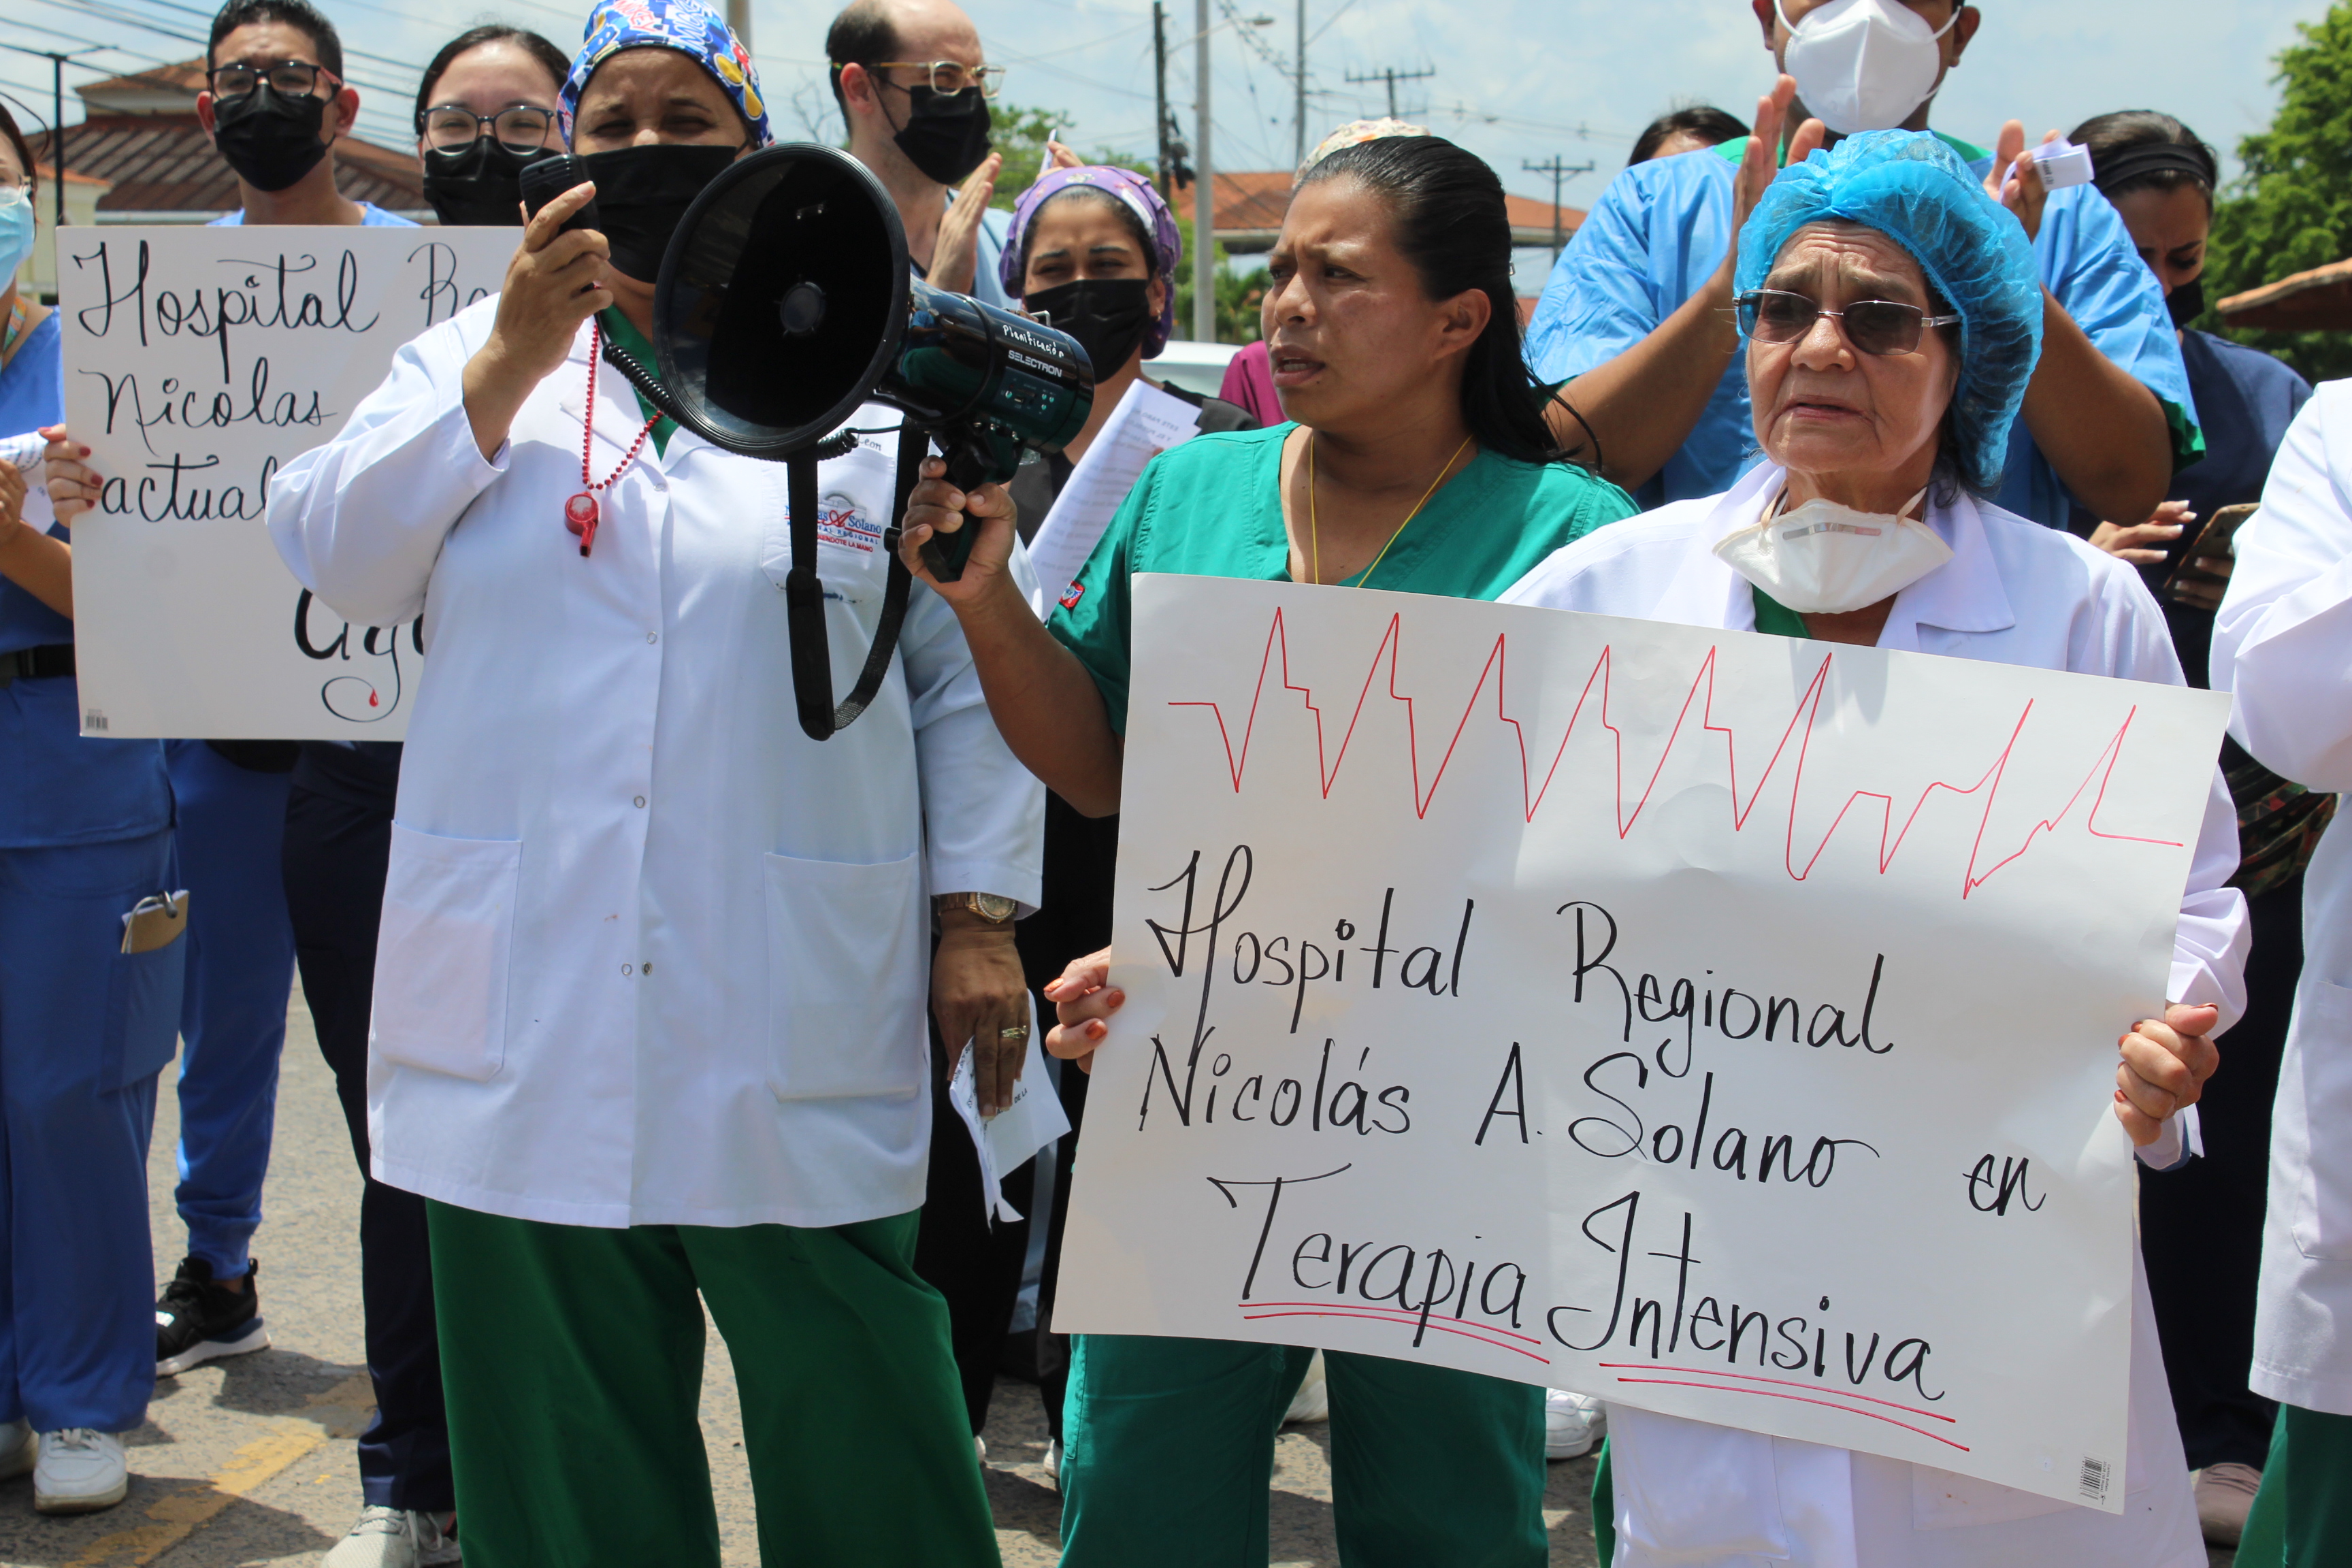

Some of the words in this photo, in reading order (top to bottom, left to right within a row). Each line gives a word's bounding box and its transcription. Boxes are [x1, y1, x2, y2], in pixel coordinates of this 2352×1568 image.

[73, 240, 380, 384] Hospital
[1008, 349, 1062, 378] SELECTRON
[837, 529, 879, 544] REGIONAL
[848, 515, 882, 534] Solano
[1145, 844, 1474, 1066] Hospital
[1556, 901, 1894, 1078] Regional
[1139, 1026, 1411, 1136] Nicolás
[1567, 1051, 1880, 1188] Solano
[1963, 1155, 2046, 1217] en
[1207, 1162, 1526, 1348] Terapia
[1547, 1191, 1946, 1401] Intensiva
